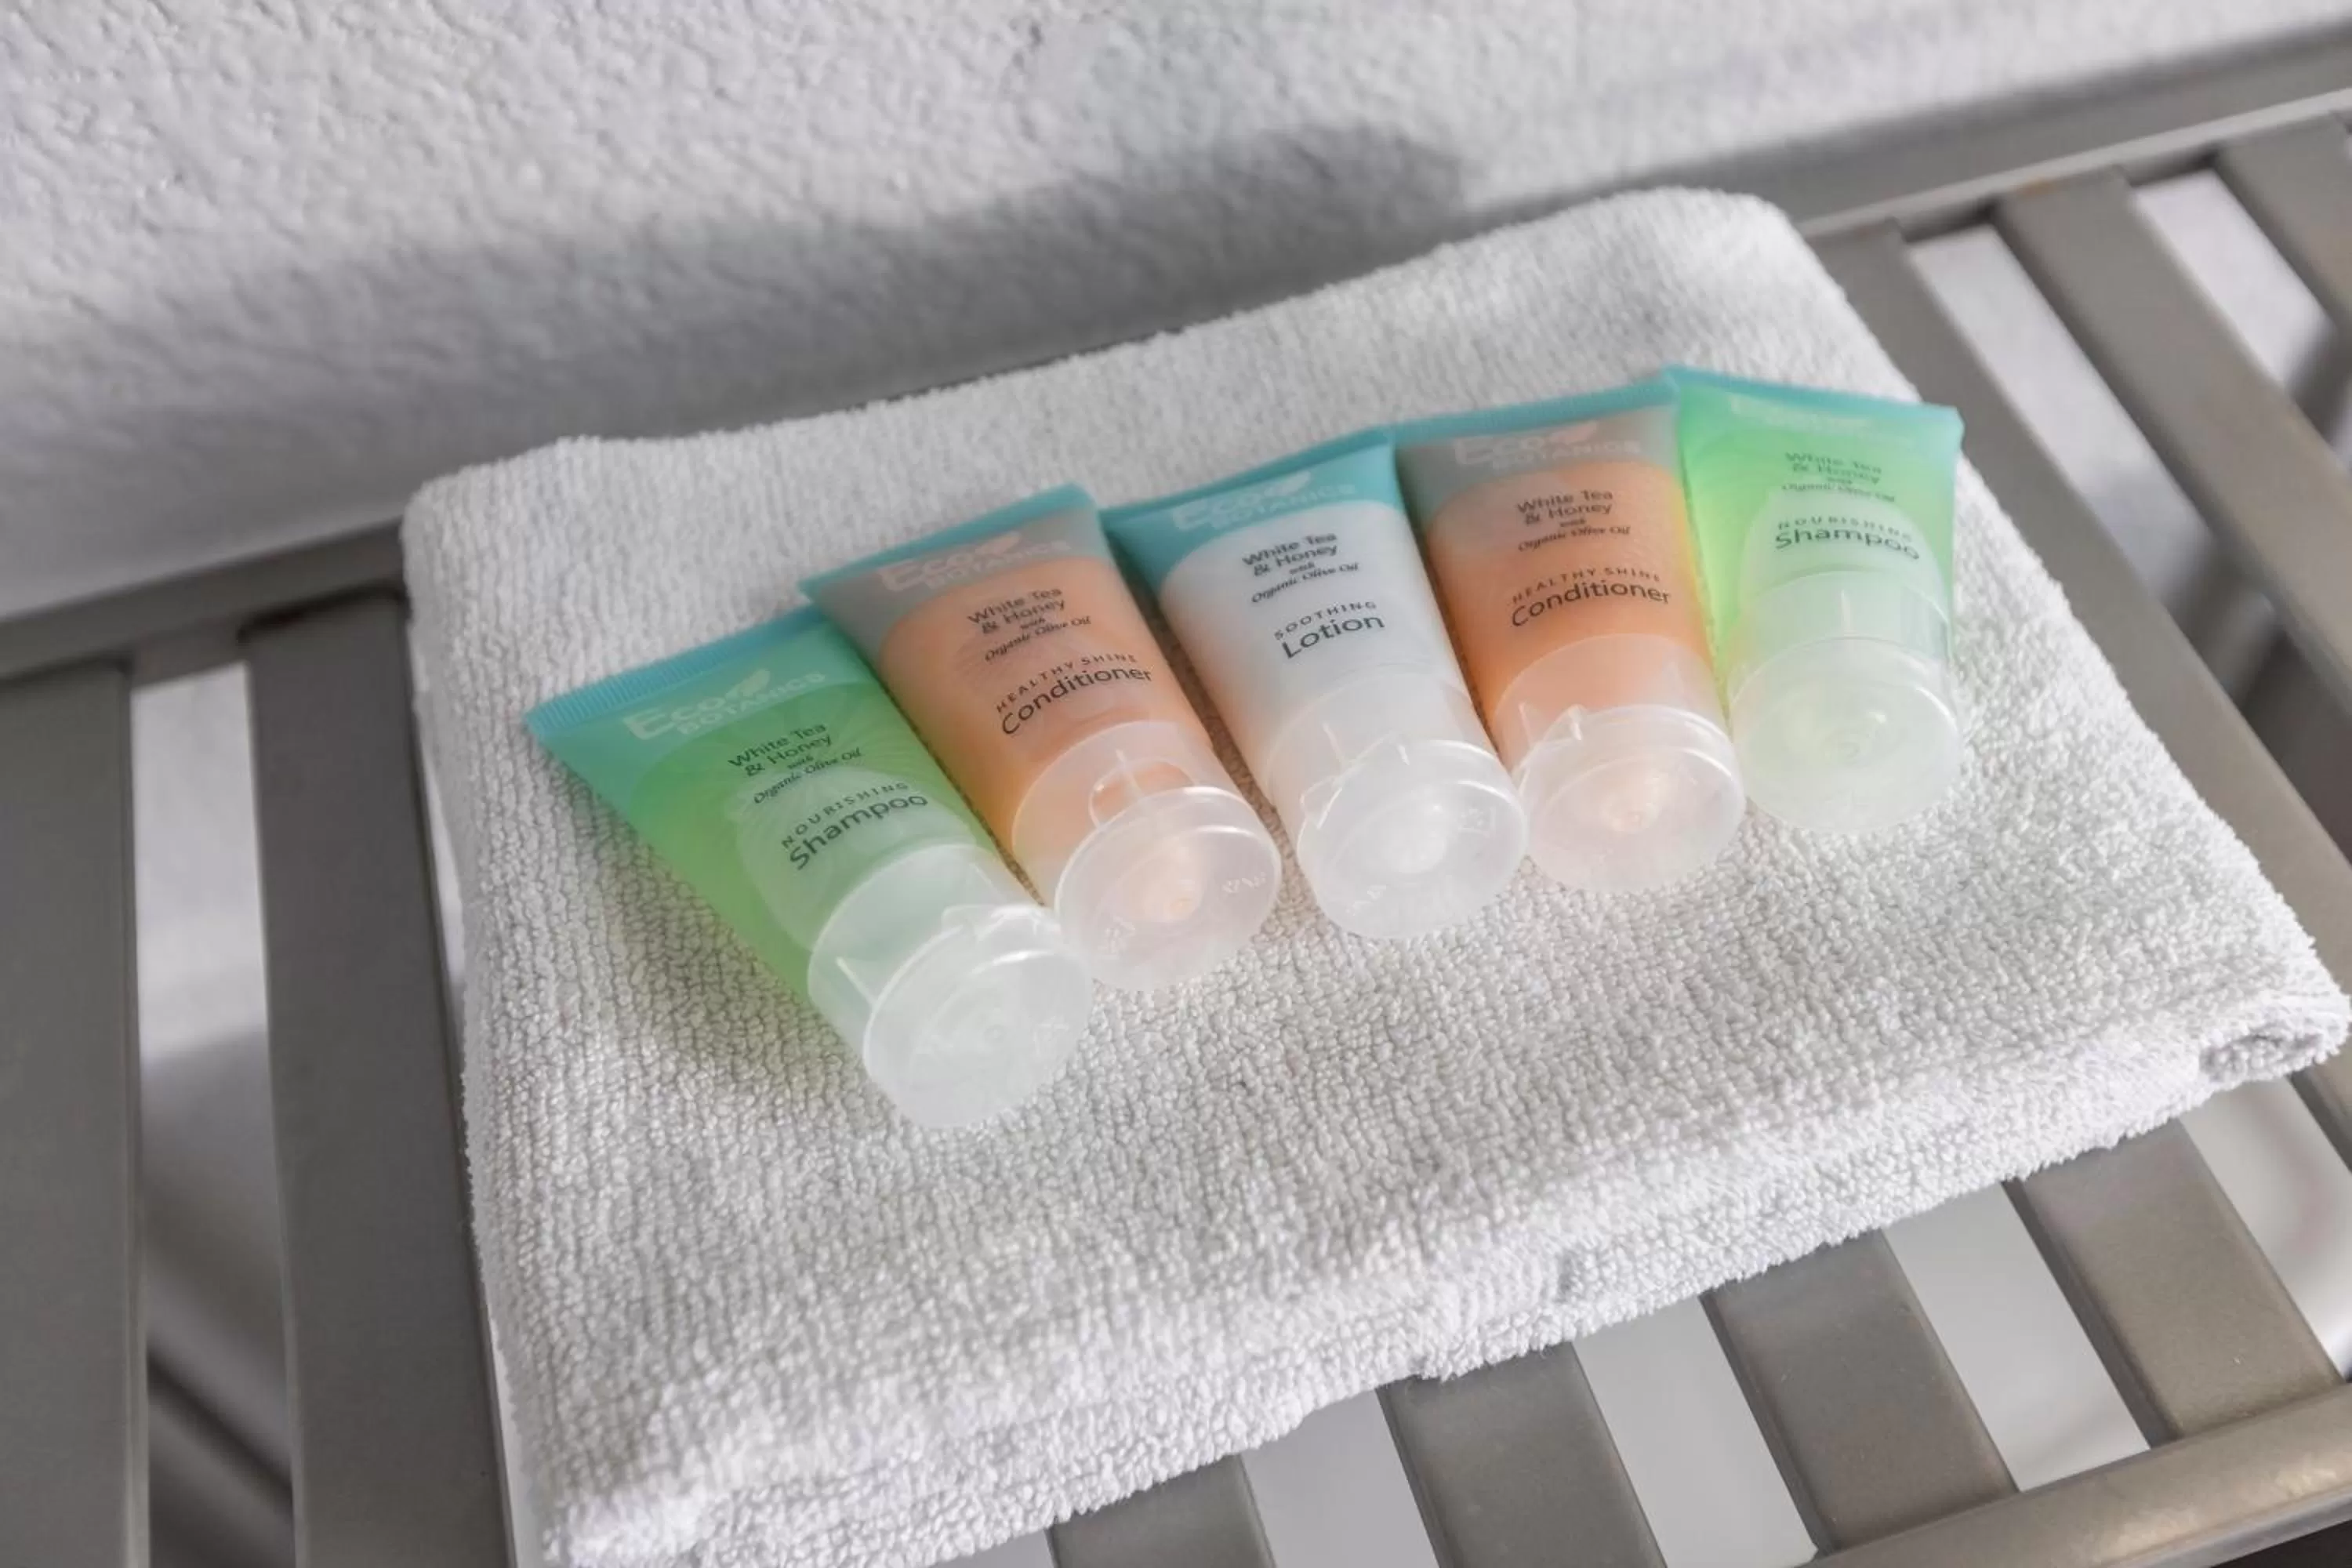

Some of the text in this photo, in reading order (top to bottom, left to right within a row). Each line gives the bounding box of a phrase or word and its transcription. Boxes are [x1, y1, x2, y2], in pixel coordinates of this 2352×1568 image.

[1517, 489, 1613, 514] White Tea
[1525, 504, 1612, 524] & Honey
[1242, 533, 1337, 565] White Tea
[1610, 526, 1631, 535] Oil
[1775, 528, 1919, 560] Shampoo
[1254, 545, 1338, 576] & Honey
[1251, 562, 1359, 603] Organic Olive Oil
[1511, 579, 1671, 626] Conditioner
[1512, 567, 1661, 604] HEALTHY SHINE
[967, 588, 1062, 624] White Tea
[982, 600, 1065, 634] & Honey
[1274, 601, 1377, 640] SOOTHING
[985, 615, 1092, 662] Organic Olive Oil
[1283, 616, 1385, 659] Lotion
[996, 653, 1138, 713] HEALTHY SHINE
[1002, 668, 1152, 735] Conditioner
[728, 724, 826, 767] White Tea
[746, 734, 831, 776] & Honey
[753, 746, 862, 804] Organic Olive Oil
[781, 782, 909, 849] NOURISHING
[789, 795, 929, 871] Shampoo
